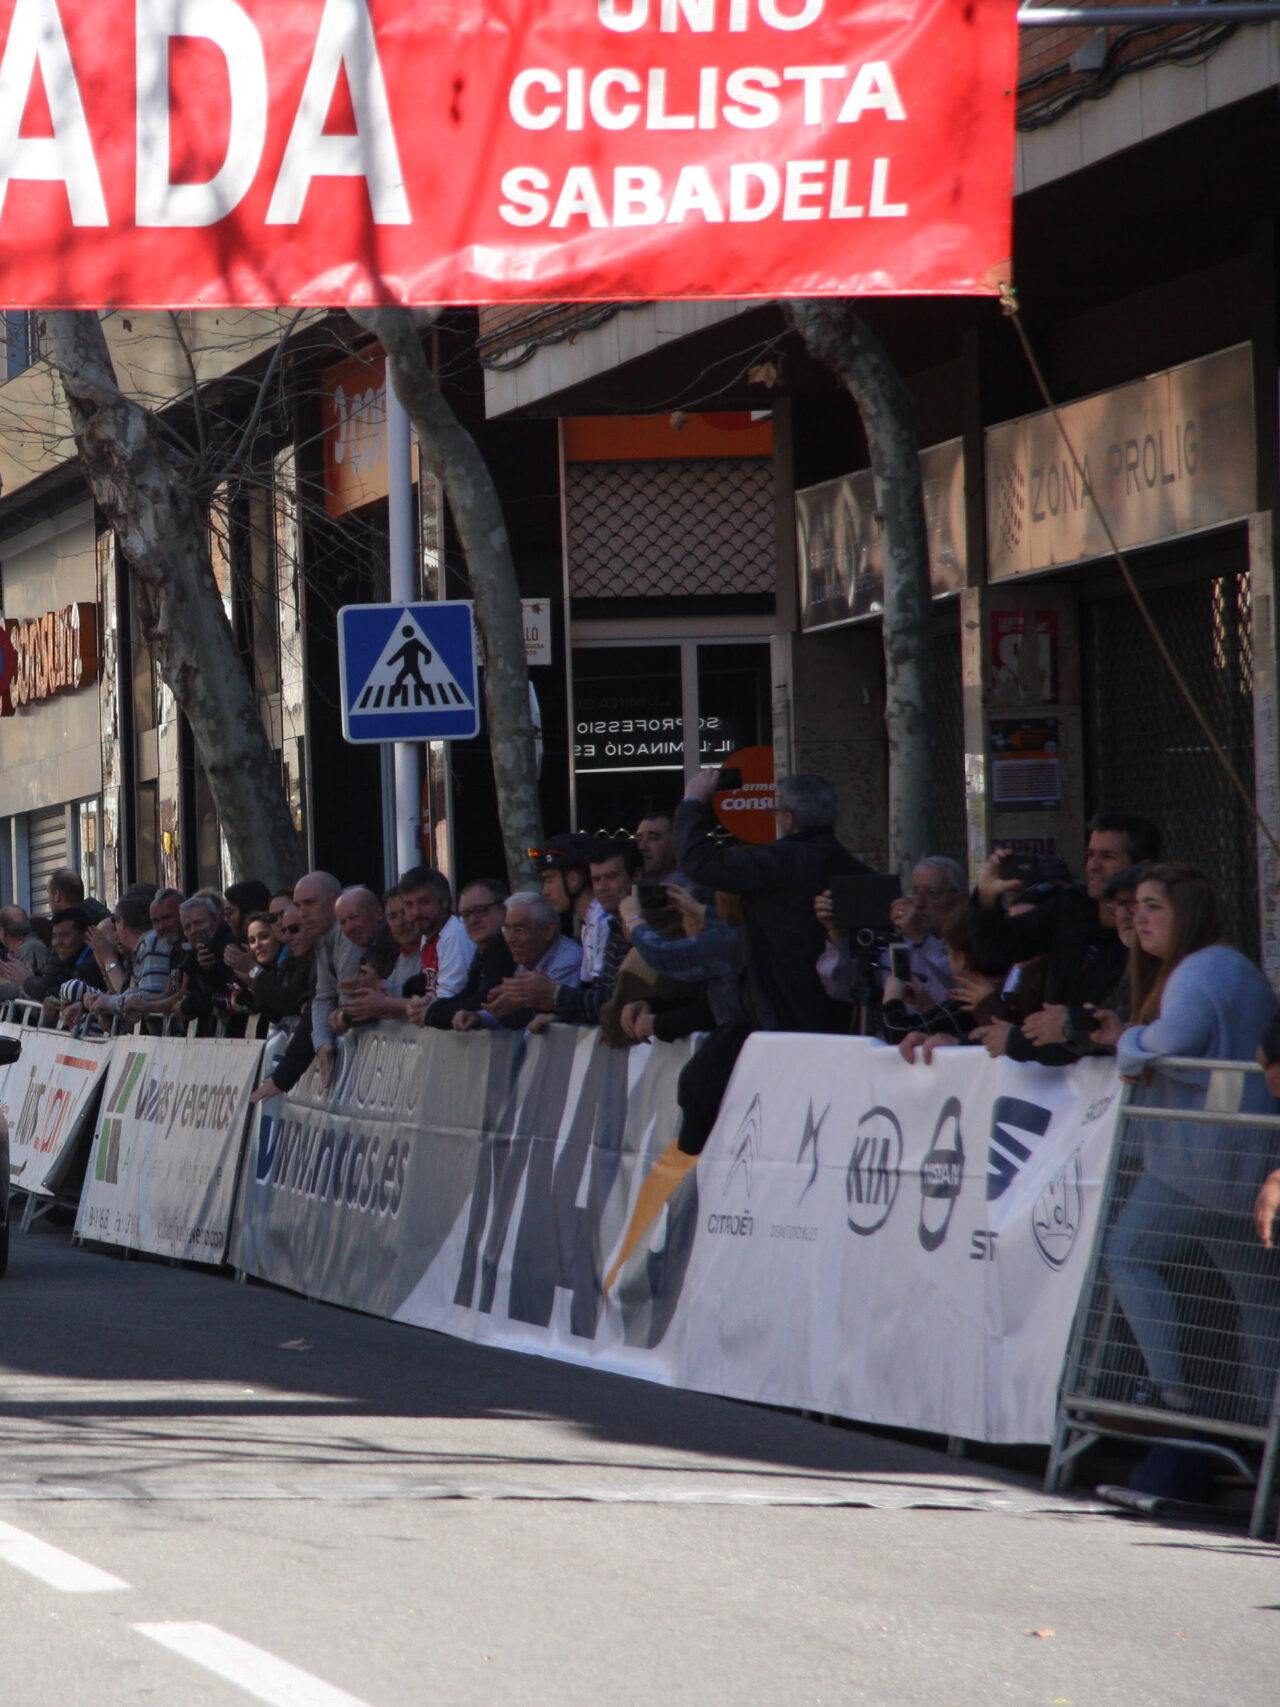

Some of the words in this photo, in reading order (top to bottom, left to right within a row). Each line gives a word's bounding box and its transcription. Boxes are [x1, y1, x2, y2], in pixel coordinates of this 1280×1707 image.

[508, 61, 906, 131] CICLISTA
[498, 157, 908, 229] SABADELL
[1030, 453, 1095, 524] ZONA
[851, 1136, 890, 1205] KIA
